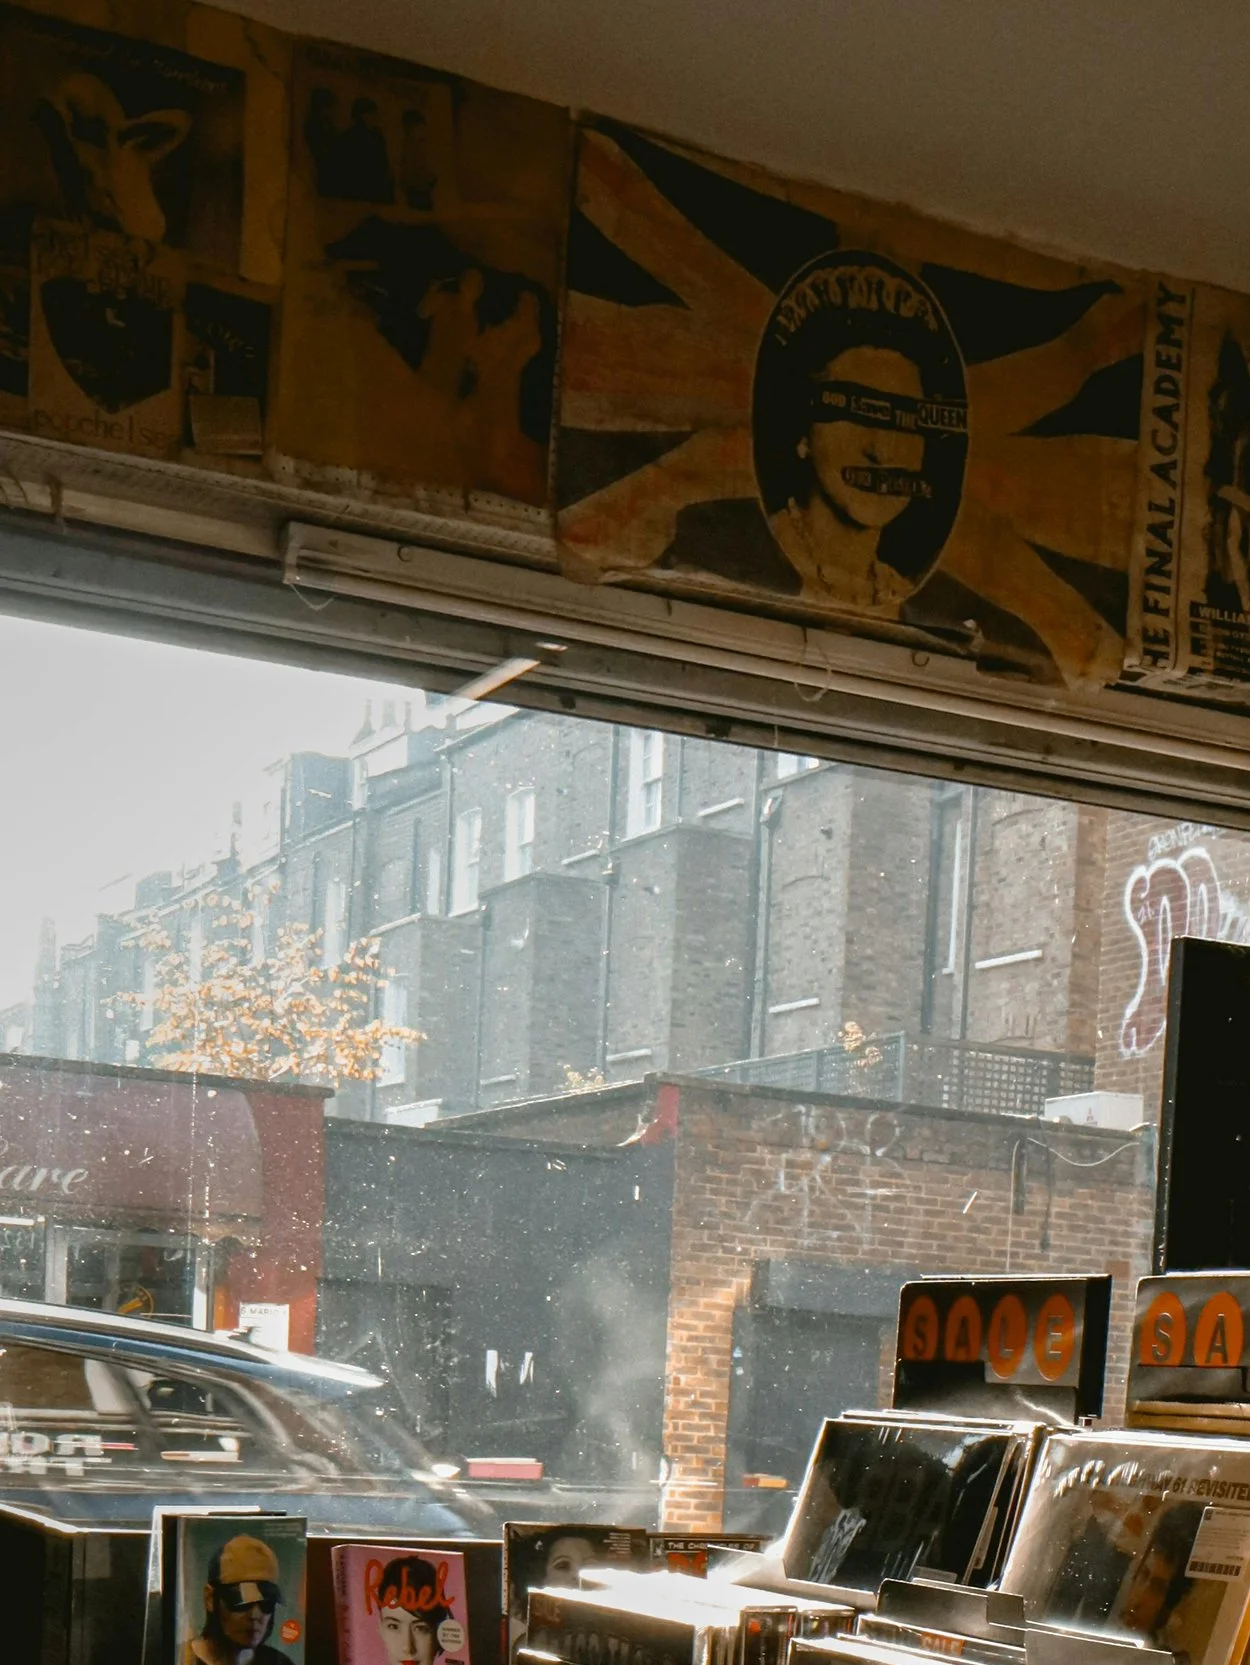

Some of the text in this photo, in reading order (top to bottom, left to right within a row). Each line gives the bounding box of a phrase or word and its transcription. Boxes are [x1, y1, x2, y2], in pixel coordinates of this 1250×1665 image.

[1149, 281, 1189, 490] ACADEMY
[917, 403, 967, 432] QUEEN
[1144, 496, 1177, 619] FINAL
[908, 1311, 1066, 1366] SALE
[1172, 1476, 1188, 1494] 61
[363, 1558, 455, 1615] Rebel
